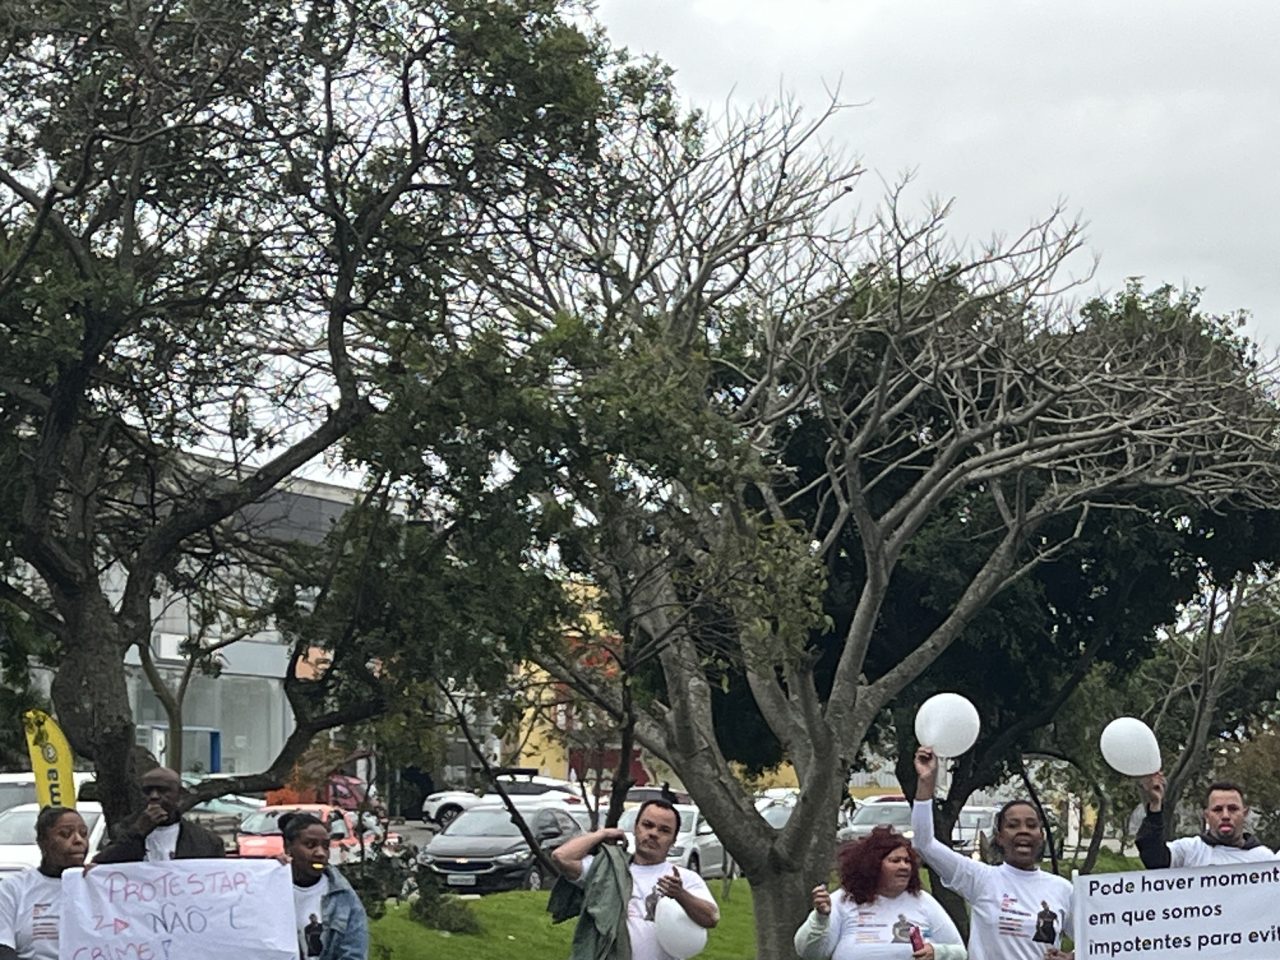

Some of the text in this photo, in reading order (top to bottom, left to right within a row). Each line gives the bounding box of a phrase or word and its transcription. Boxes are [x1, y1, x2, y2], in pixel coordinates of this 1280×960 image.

[105, 871, 253, 904] PROTESTAR
[1090, 878, 1134, 896] Pode
[1142, 876, 1194, 891] haver
[1089, 905, 1221, 926] em que somos
[1090, 935, 1191, 957] impotentes
[1198, 933, 1241, 950] para
